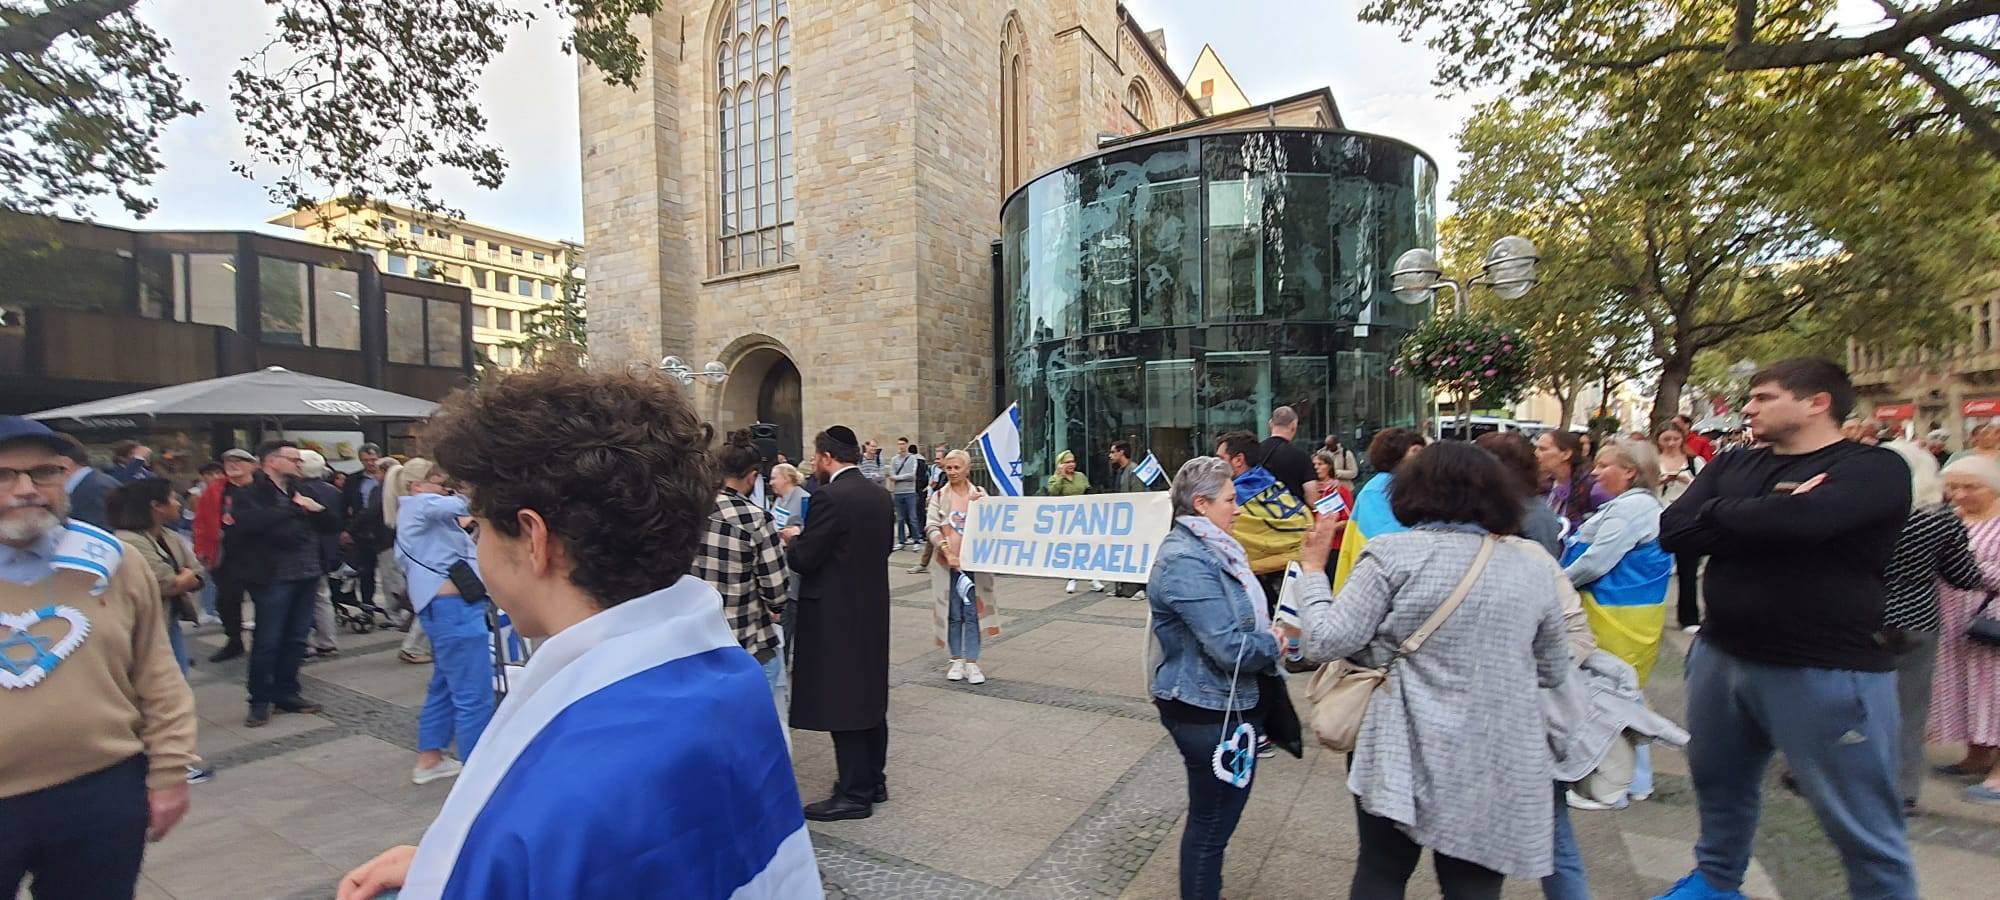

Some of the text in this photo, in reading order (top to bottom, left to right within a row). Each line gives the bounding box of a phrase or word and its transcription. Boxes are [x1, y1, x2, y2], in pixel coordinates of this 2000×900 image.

[978, 502, 1134, 535] WE STAND
[972, 538, 1150, 574] WITH ISRAEL!
